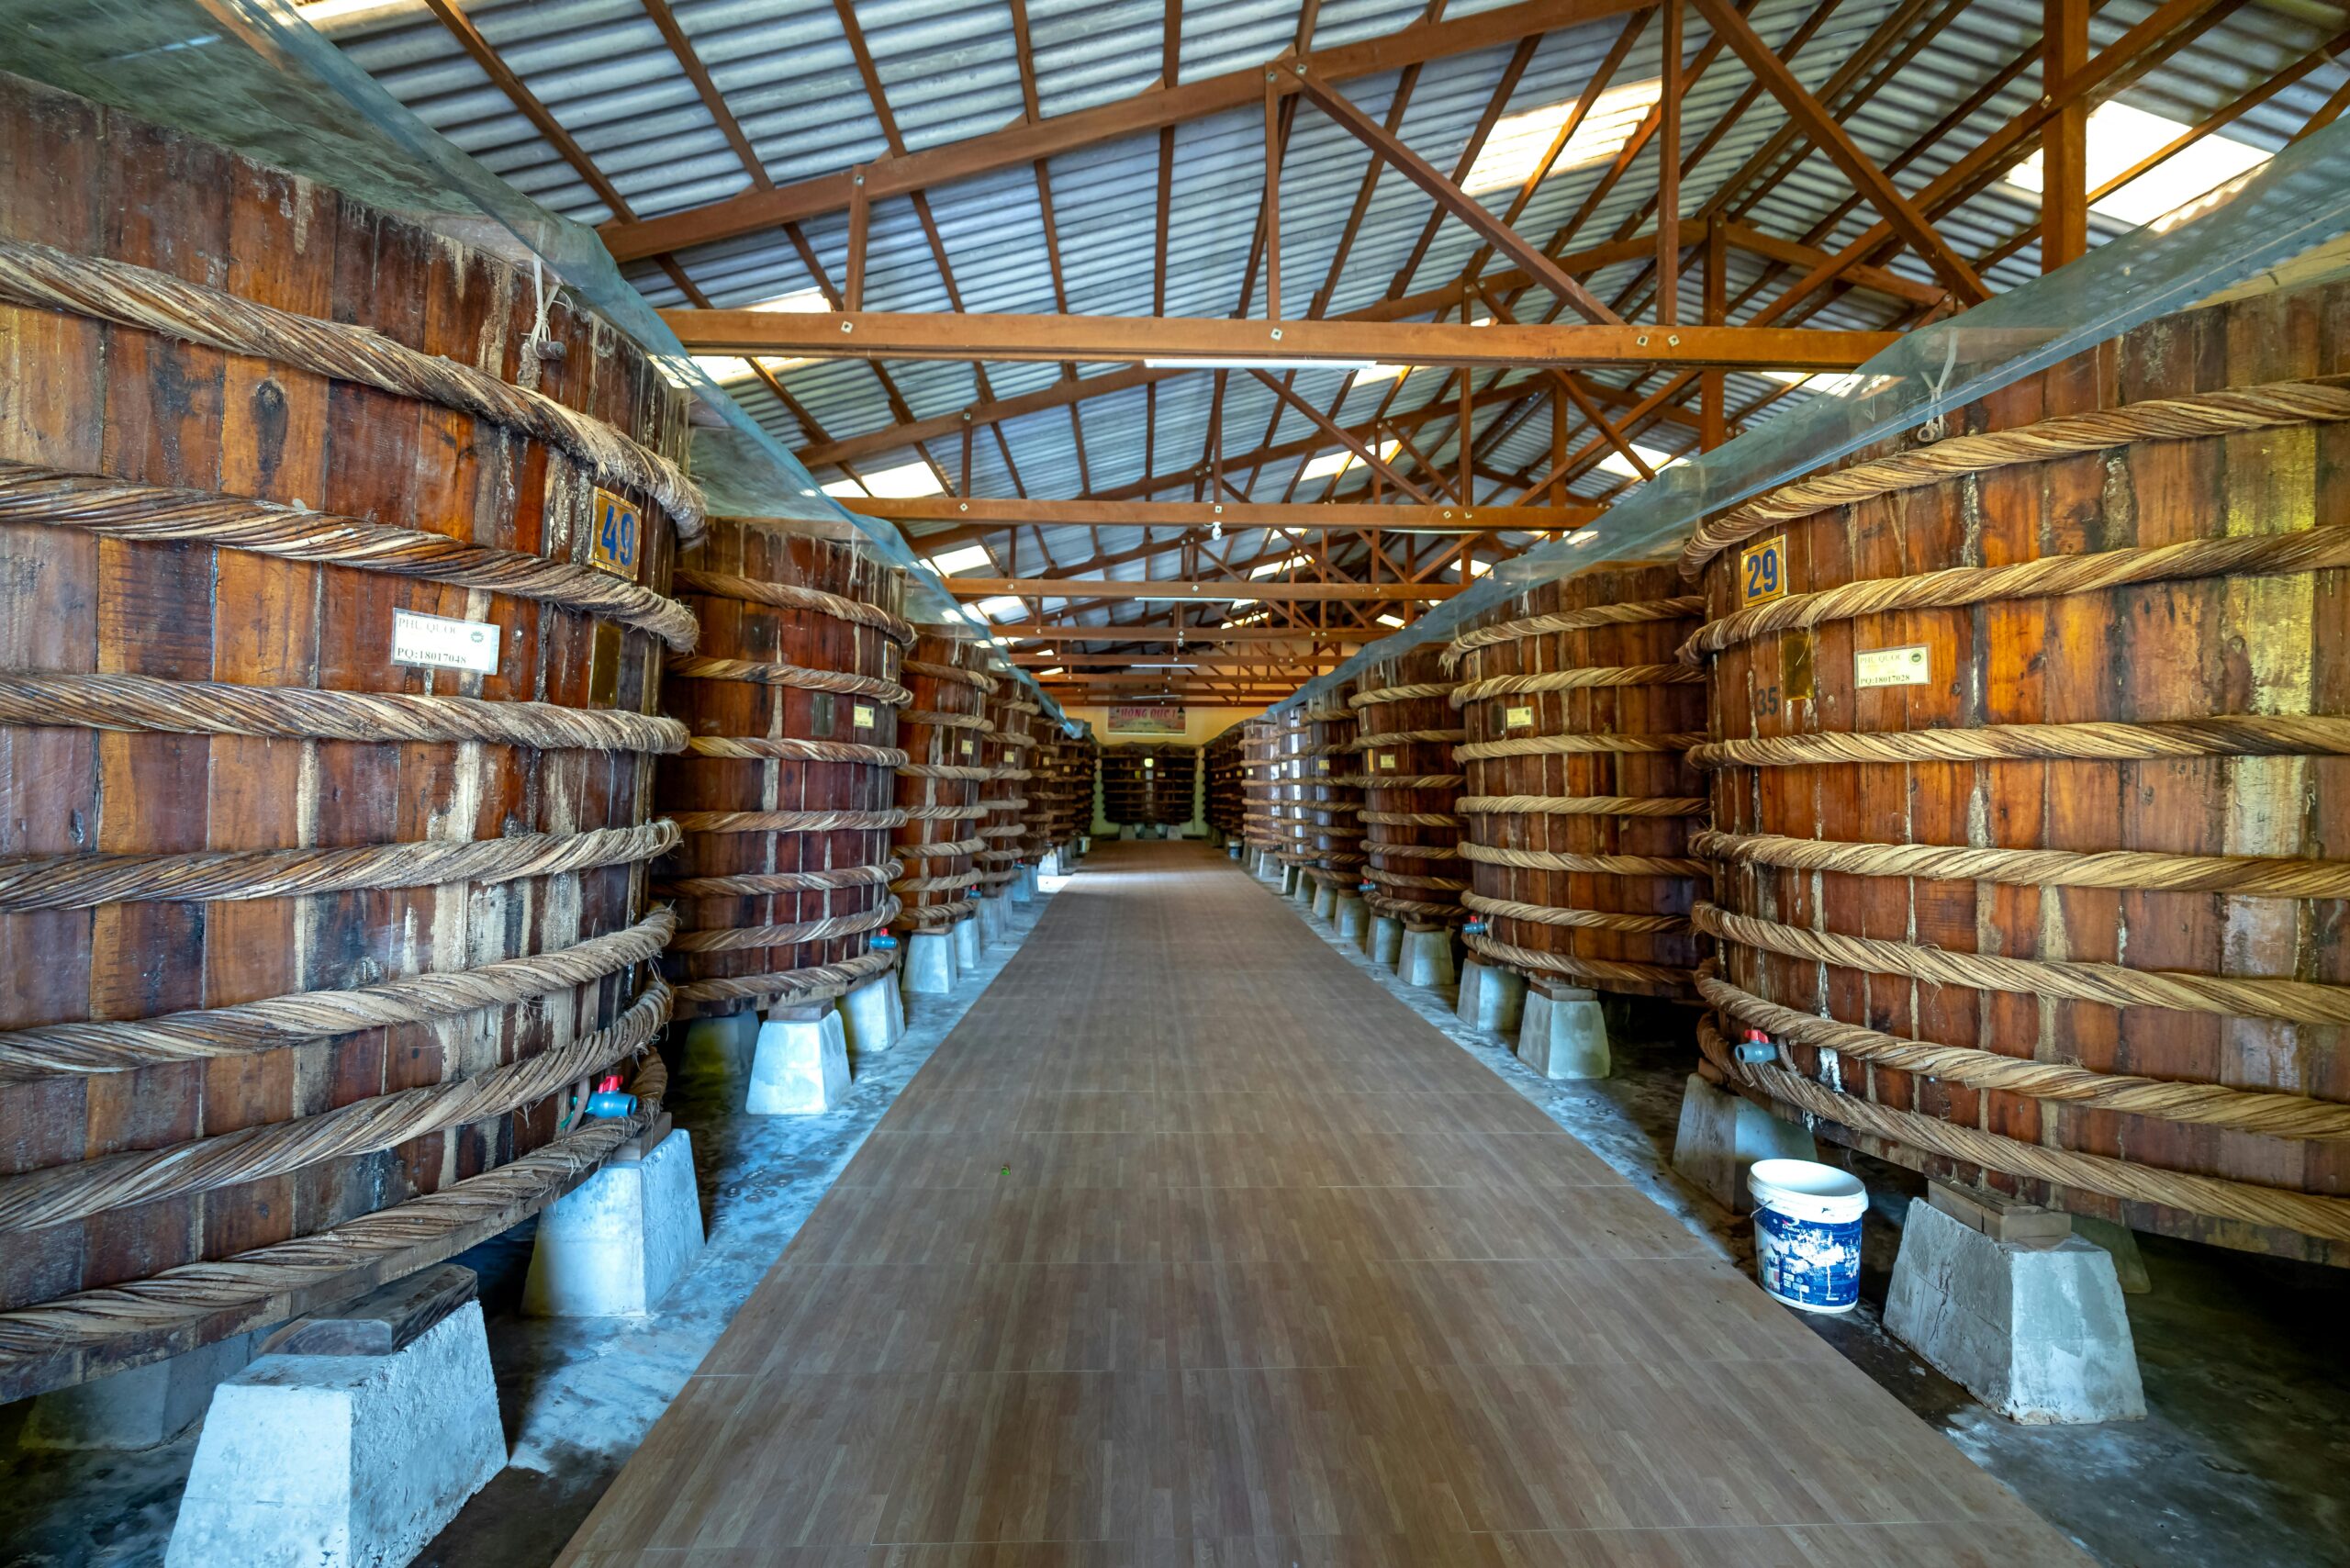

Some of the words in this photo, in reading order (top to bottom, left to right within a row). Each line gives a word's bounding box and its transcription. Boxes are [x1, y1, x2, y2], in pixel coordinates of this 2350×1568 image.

[601, 505, 634, 566] 49
[1748, 548, 1778, 599] 29
[397, 647, 467, 665] PQ:18017048
[1860, 674, 1910, 685] PQ:18017028
[1756, 687, 1779, 719] 35
